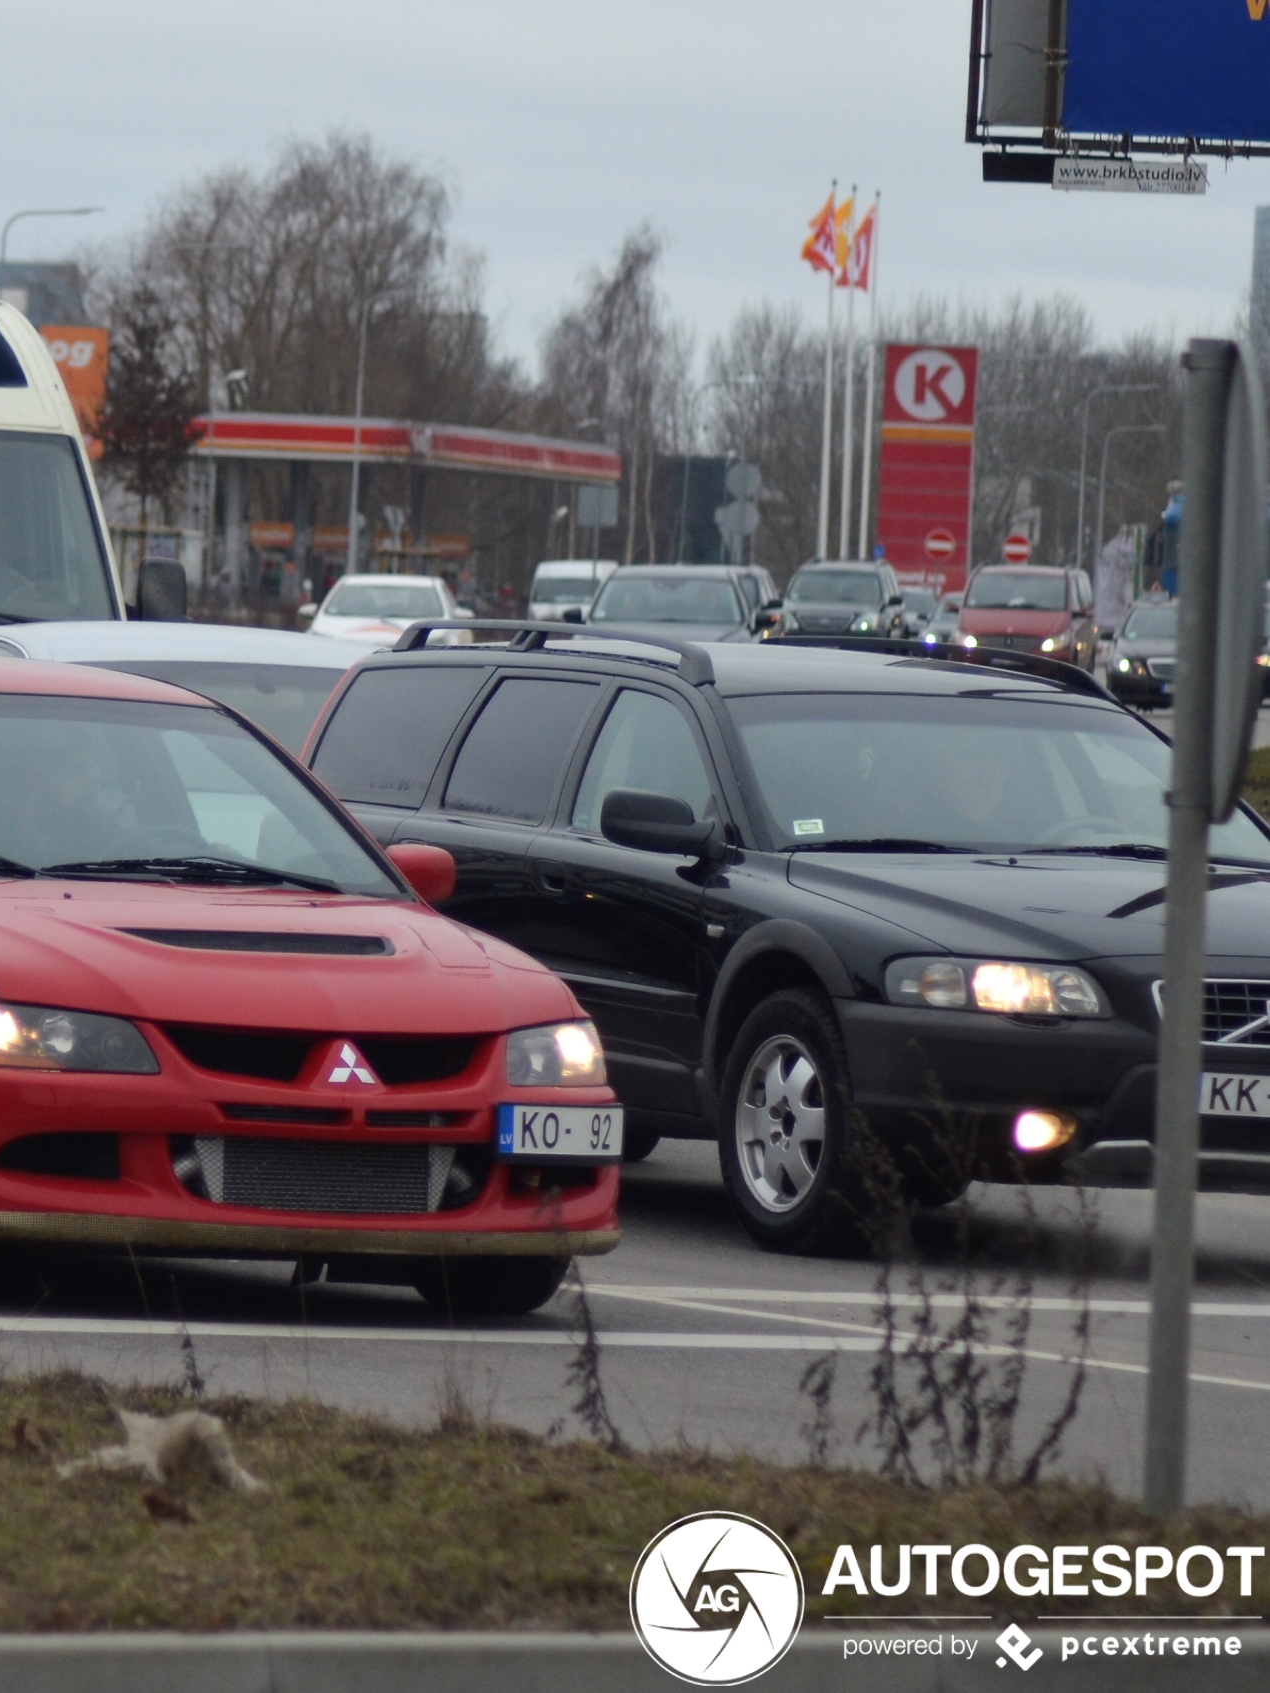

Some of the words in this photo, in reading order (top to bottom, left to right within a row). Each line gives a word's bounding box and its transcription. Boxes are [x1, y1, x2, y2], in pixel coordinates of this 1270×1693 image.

[1060, 166, 1201, 181] www.brkbstudio.lv
[41, 334, 95, 368] og
[1209, 1077, 1270, 1112] KK
[500, 1134, 512, 1144] LV
[590, 1113, 612, 1150] 92
